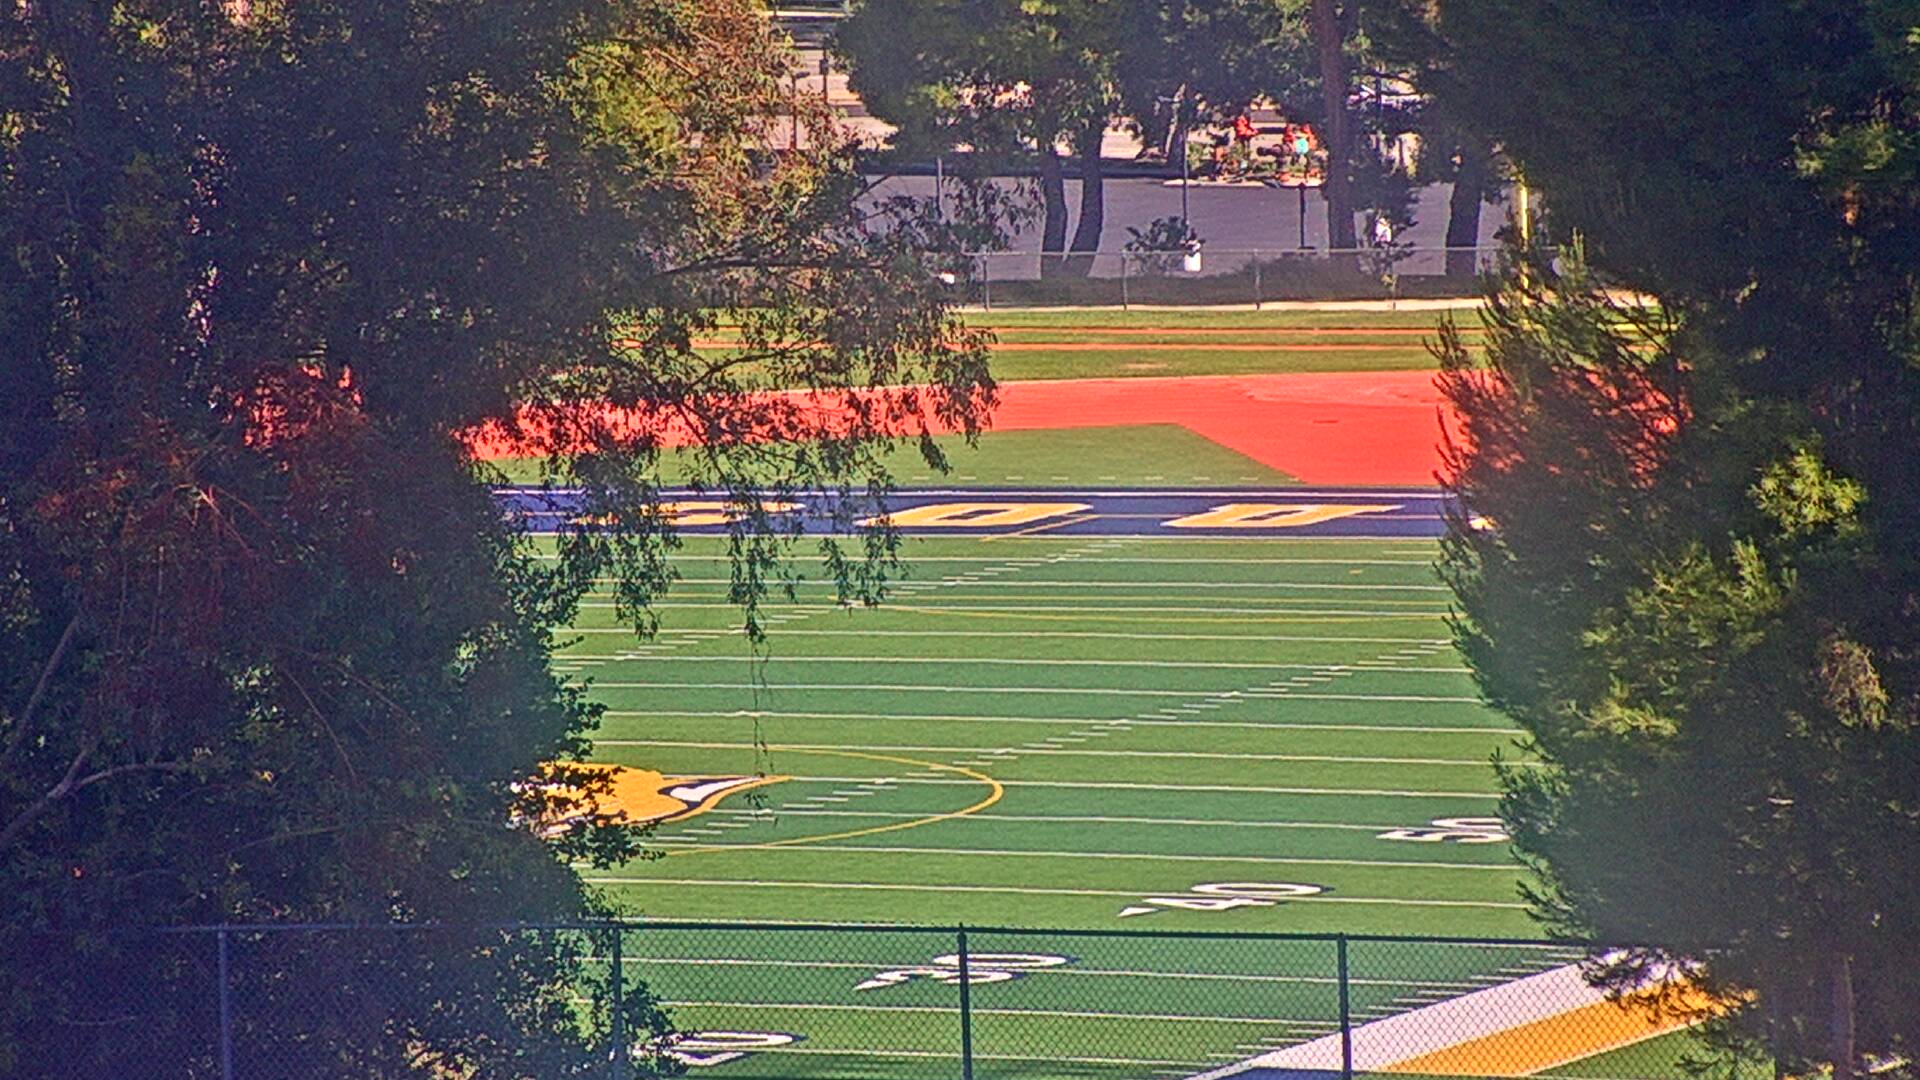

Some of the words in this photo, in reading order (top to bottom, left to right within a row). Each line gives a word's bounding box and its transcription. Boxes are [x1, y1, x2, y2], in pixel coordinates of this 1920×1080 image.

[567, 500, 1496, 528] SOU
[1141, 881, 1322, 910] 40
[872, 953, 1068, 985] 30
